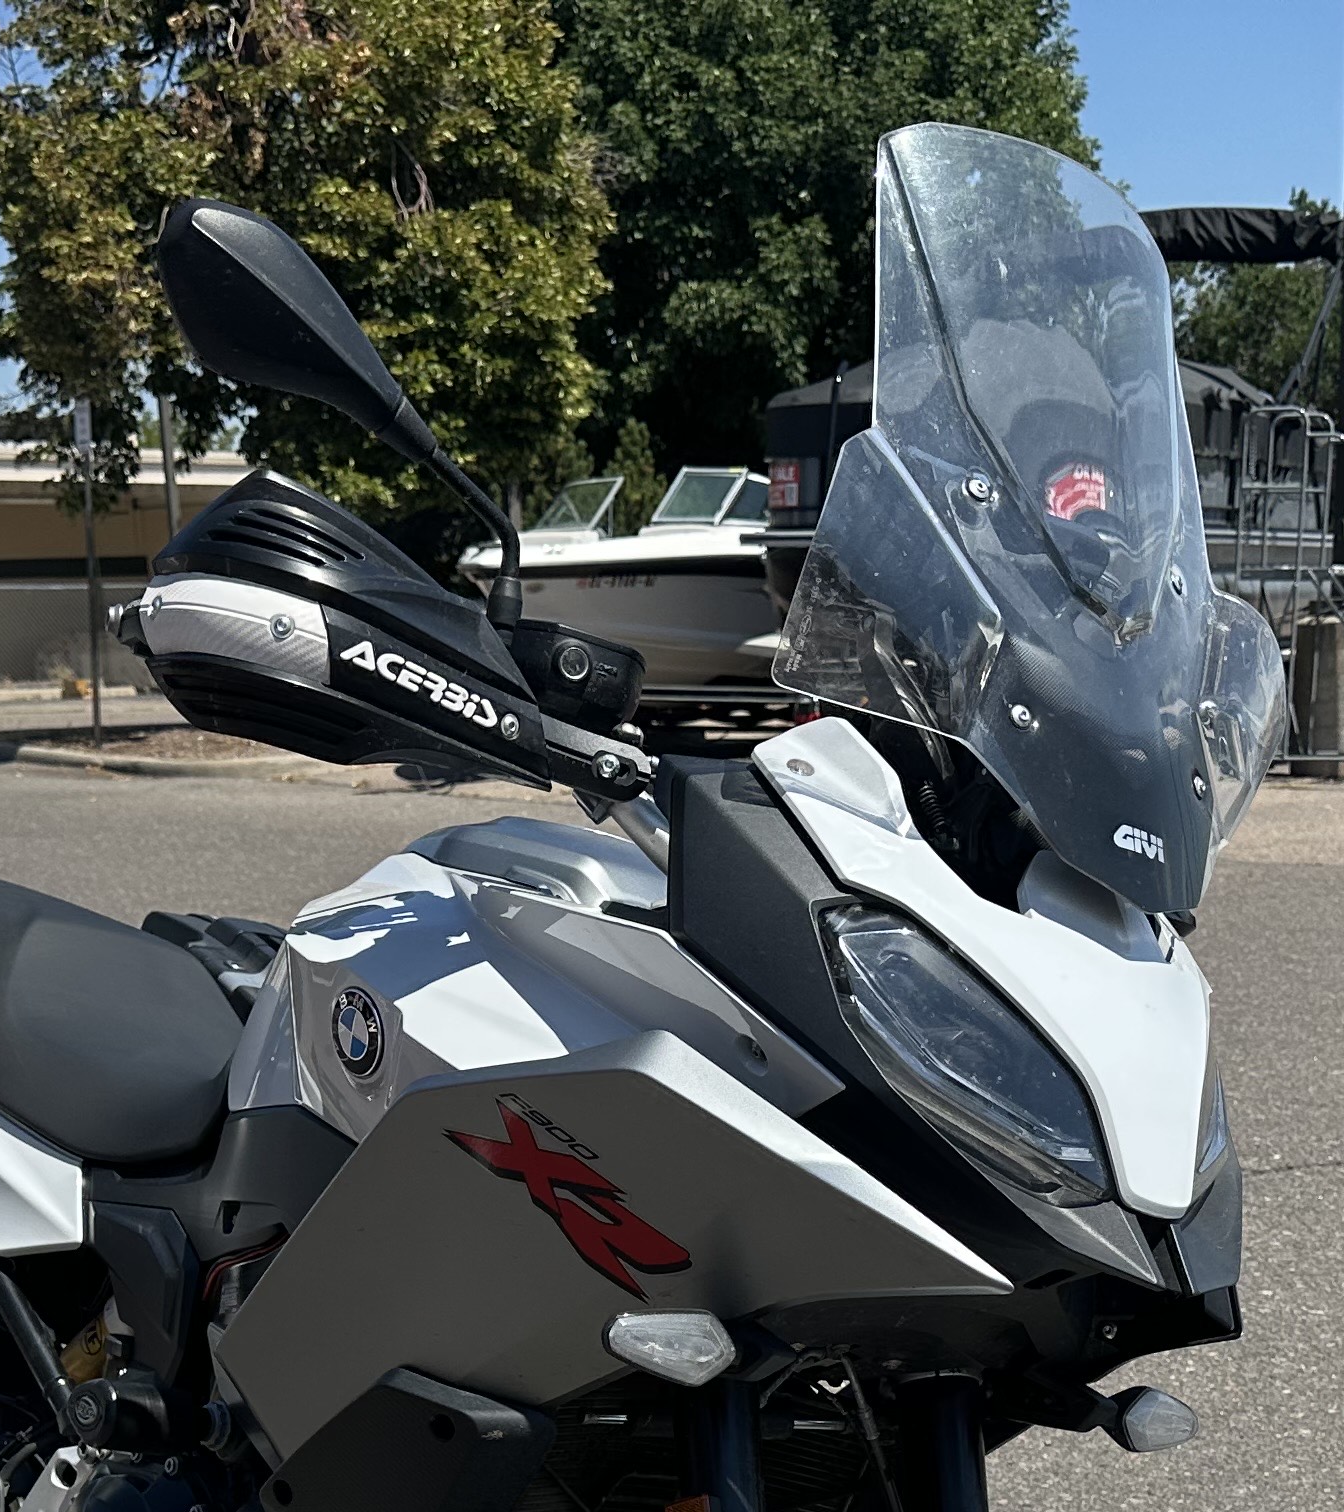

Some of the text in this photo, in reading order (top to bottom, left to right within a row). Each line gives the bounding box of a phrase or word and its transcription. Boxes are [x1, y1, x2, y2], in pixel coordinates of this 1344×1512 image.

[340, 640, 498, 728] ACERBIS
[1113, 824, 1165, 864] GIVI
[338, 993, 378, 1033] BMW
[498, 1093, 600, 1160] F900
[441, 1097, 693, 1306] XR
